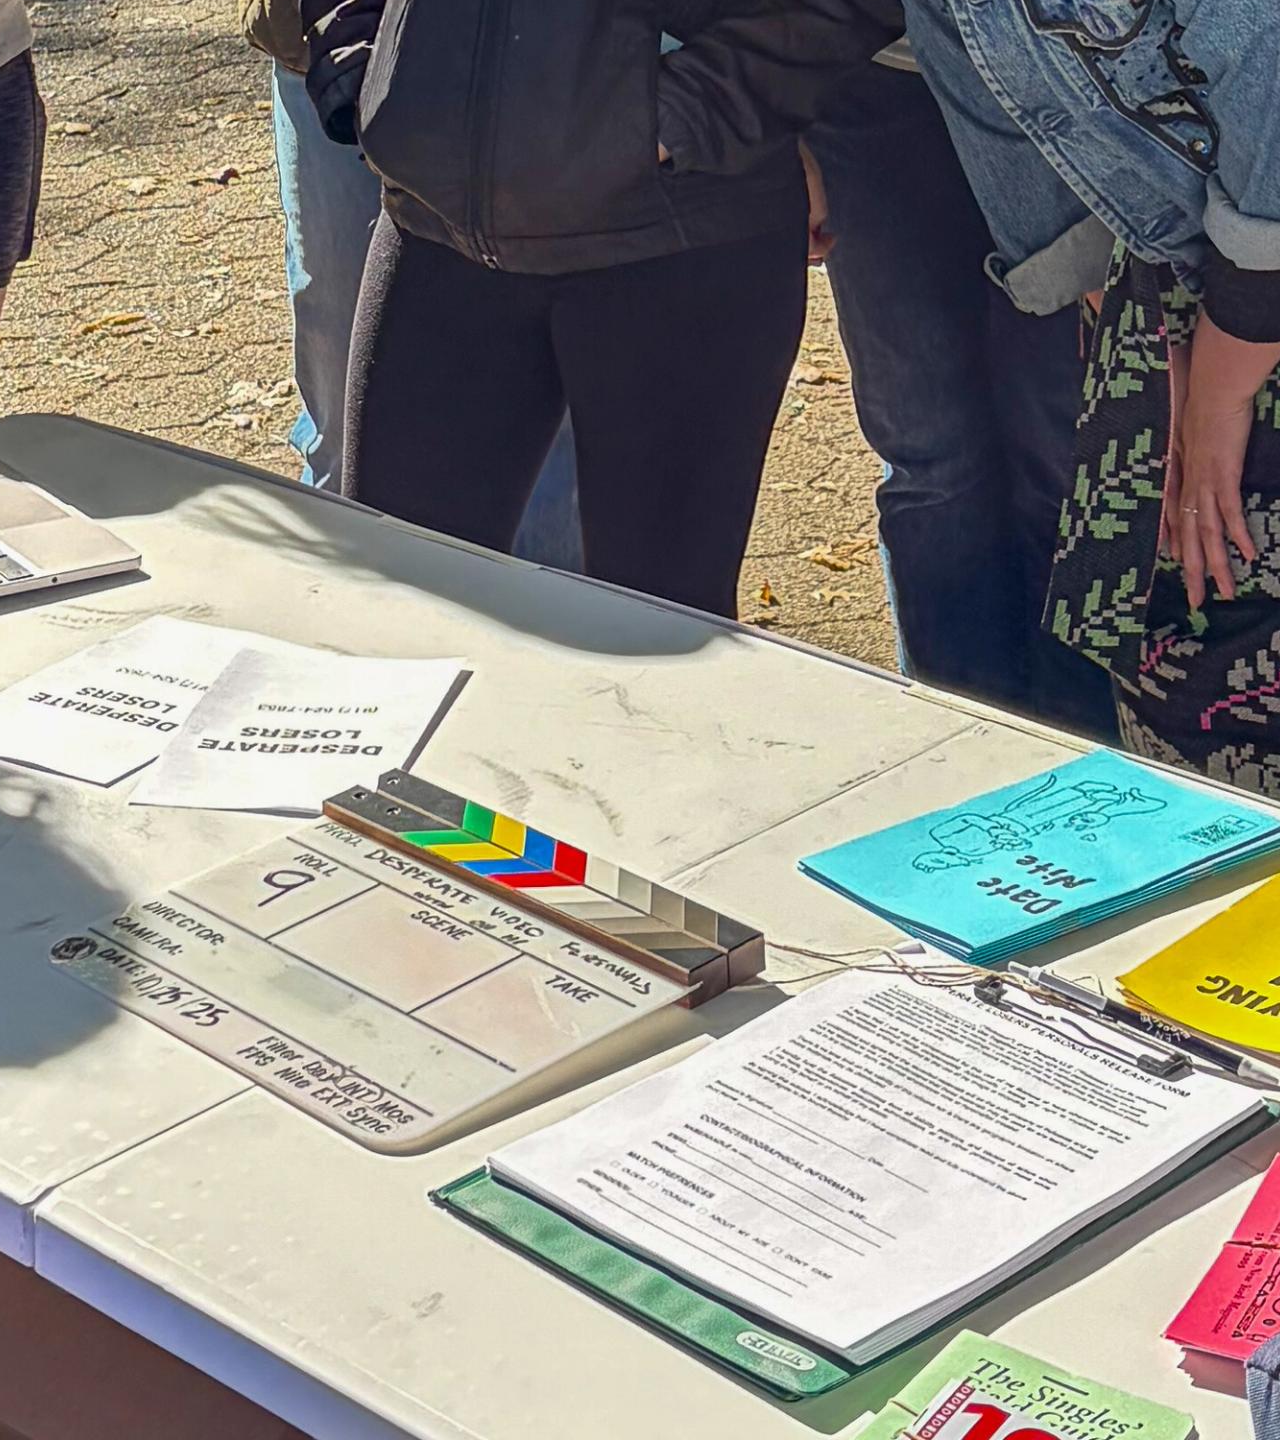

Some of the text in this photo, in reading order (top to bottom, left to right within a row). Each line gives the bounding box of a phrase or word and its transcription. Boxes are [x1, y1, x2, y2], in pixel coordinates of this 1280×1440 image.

[28, 690, 180, 732] DESPERATE
[76, 688, 176, 716] LOSERS
[198, 736, 382, 756] DESPERATE
[240, 726, 362, 740] LOSERS
[294, 854, 338, 878] ROLL
[1016, 854, 1096, 888] Nite
[258, 866, 320, 908] 9
[364, 848, 478, 904] DESPERATE
[490, 906, 544, 938] VIDEO
[976, 878, 1064, 918] Date
[110, 910, 182, 956] CAMERA:
[142, 902, 224, 946] DIRECTOR:
[410, 910, 474, 940] SCENE
[94, 948, 142, 976] DATE:
[544, 974, 600, 1002] TAKE
[256, 1036, 304, 1062] Filter
[300, 1055, 340, 1082] Day
[339, 1076, 377, 1105] INT
[1030, 1028, 1100, 1060] PERSONALS
[1100, 1058, 1152, 1084] RELEASE
[1154, 1082, 1190, 1098] FORM
[236, 1046, 394, 1138] FPS Nite EXT Sync
[626, 1152, 658, 1168] MATCH
[804, 1168, 866, 1202] INFORMATION
[974, 1358, 1144, 1434] The Singles'
